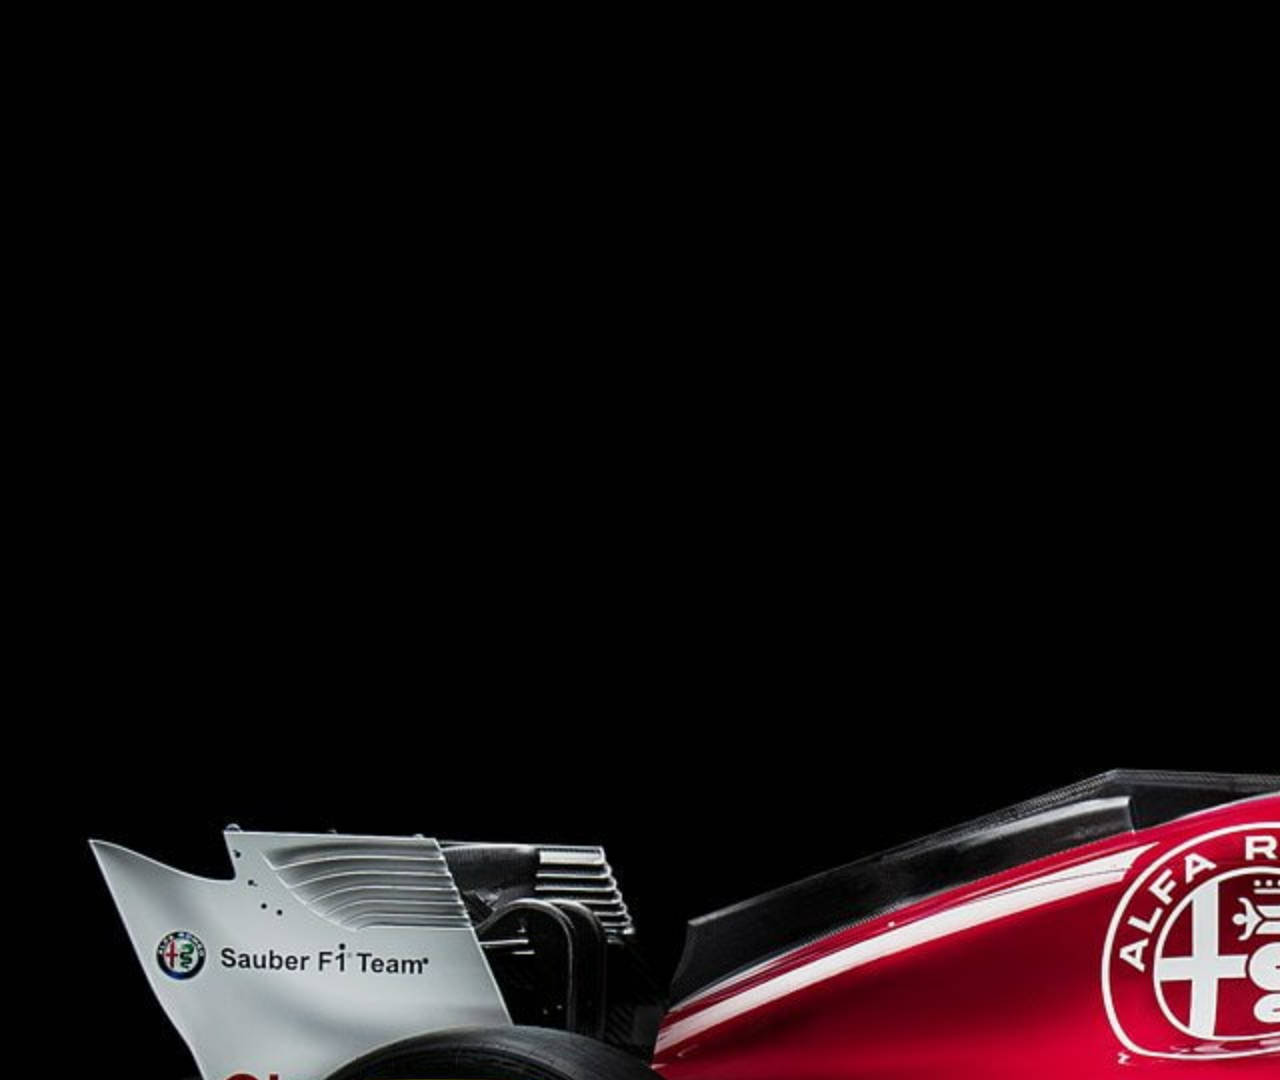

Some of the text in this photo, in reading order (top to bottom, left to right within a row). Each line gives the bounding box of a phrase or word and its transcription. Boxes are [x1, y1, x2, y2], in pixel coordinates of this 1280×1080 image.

[1119, 852, 1216, 972] ALFA
[221, 948, 423, 974] Sauber F1 Team
